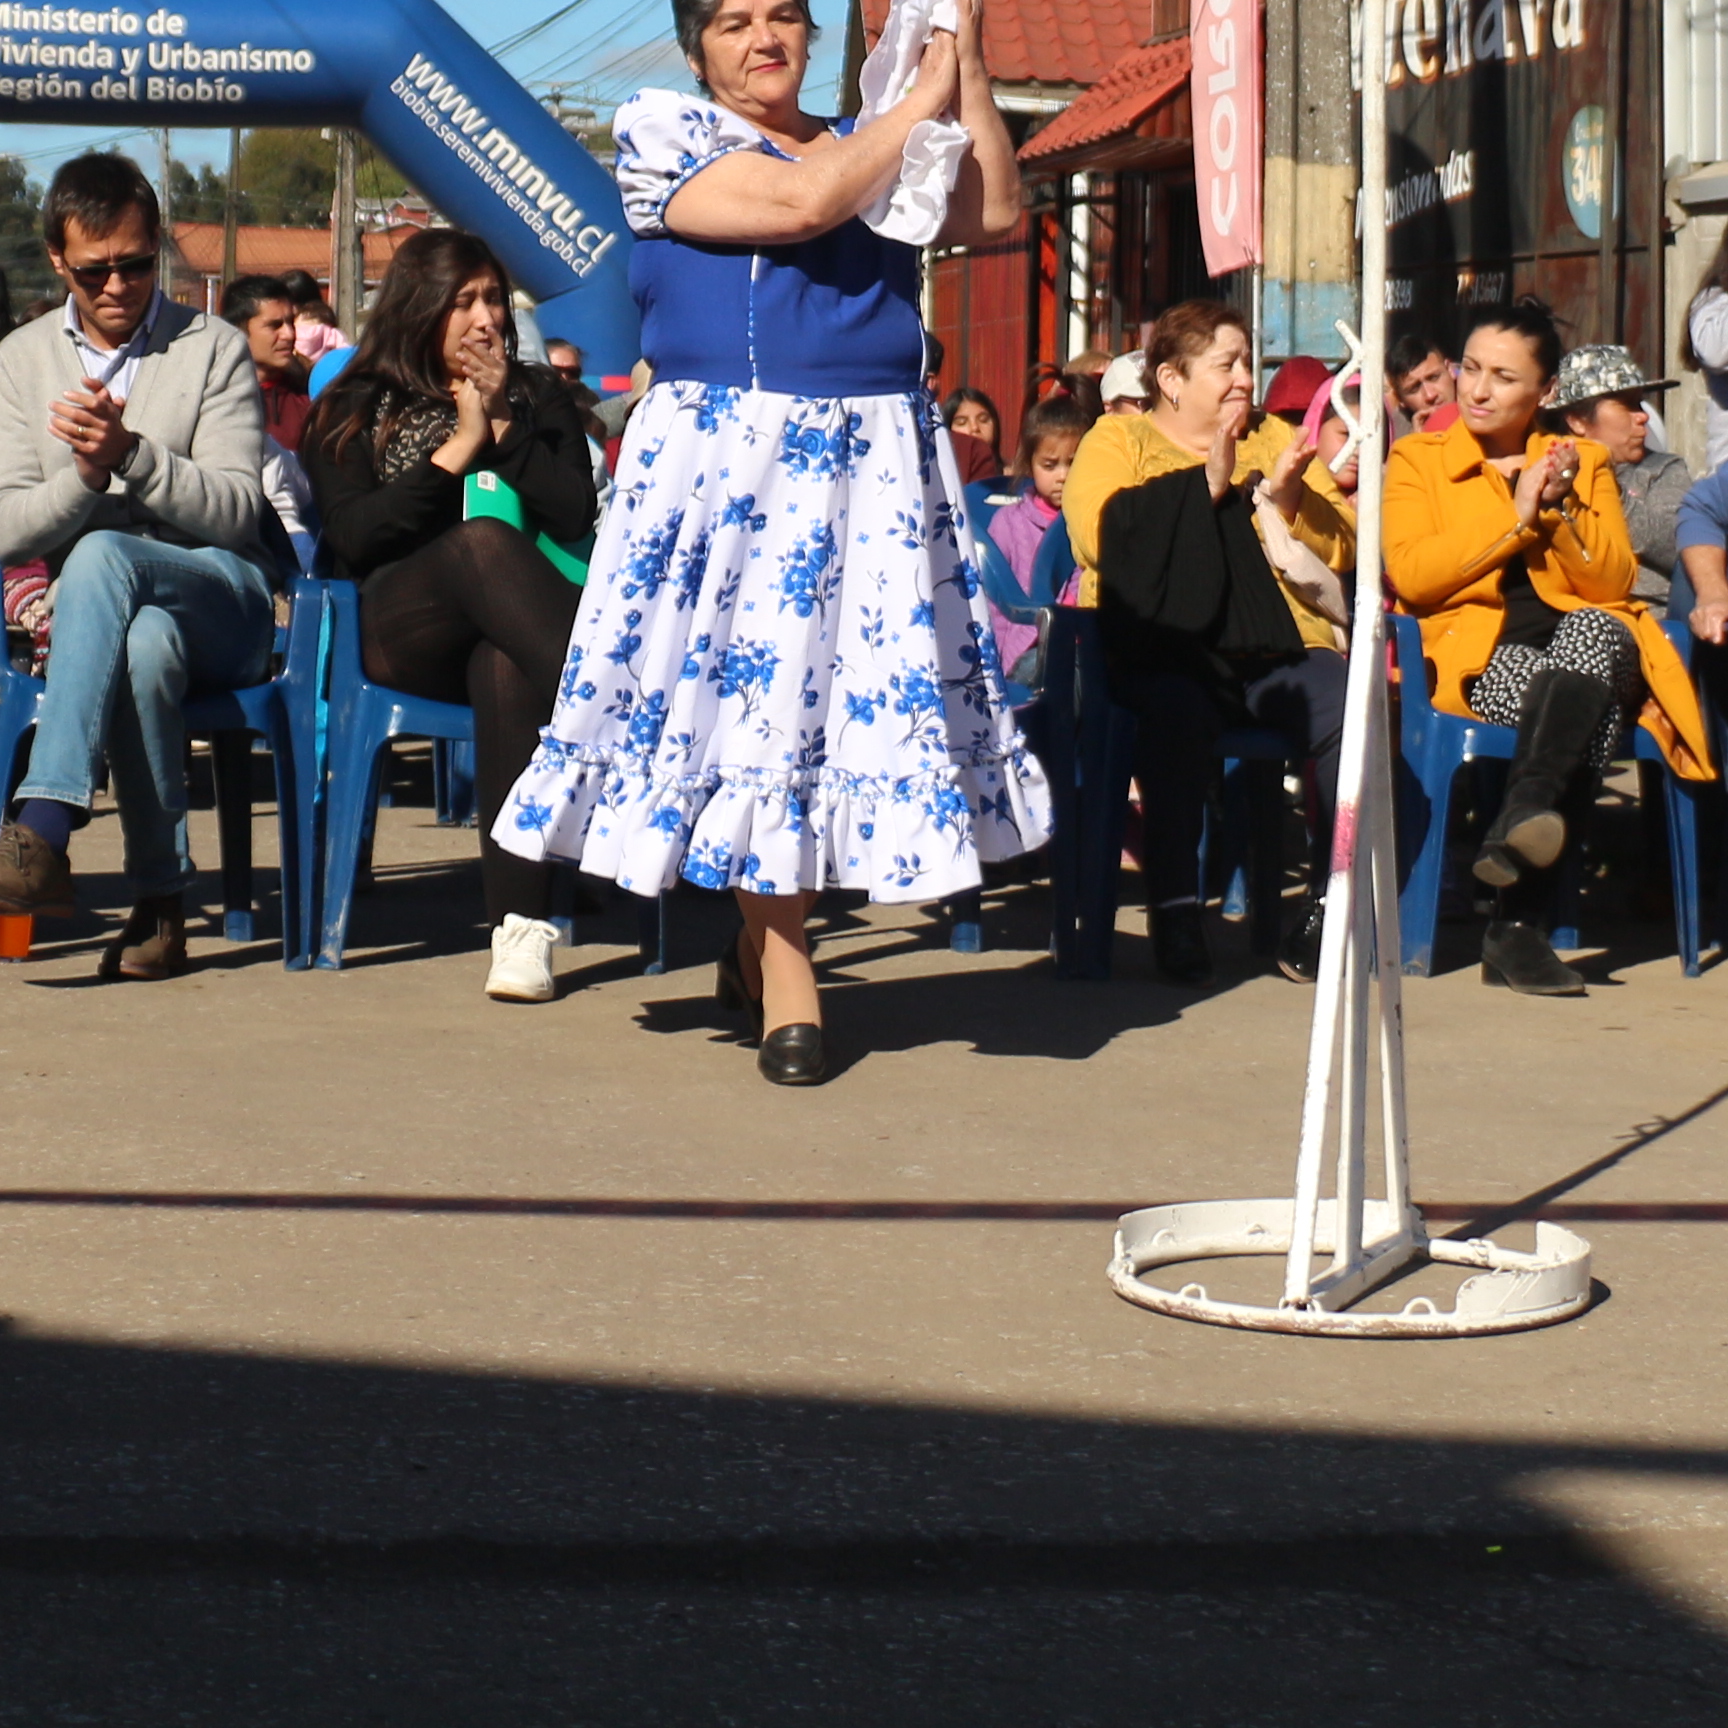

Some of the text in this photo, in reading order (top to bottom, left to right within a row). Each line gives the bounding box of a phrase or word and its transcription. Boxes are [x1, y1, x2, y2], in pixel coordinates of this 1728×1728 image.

[145, 9, 188, 36] de
[120, 46, 141, 75] y
[147, 43, 314, 73] Urbanismo
[90, 75, 138, 101] del
[146, 76, 245, 103] Biobío
[404, 52, 618, 263] www.minvu.cl
[389, 74, 595, 279] biobio.seremivivienda.gob.cl
